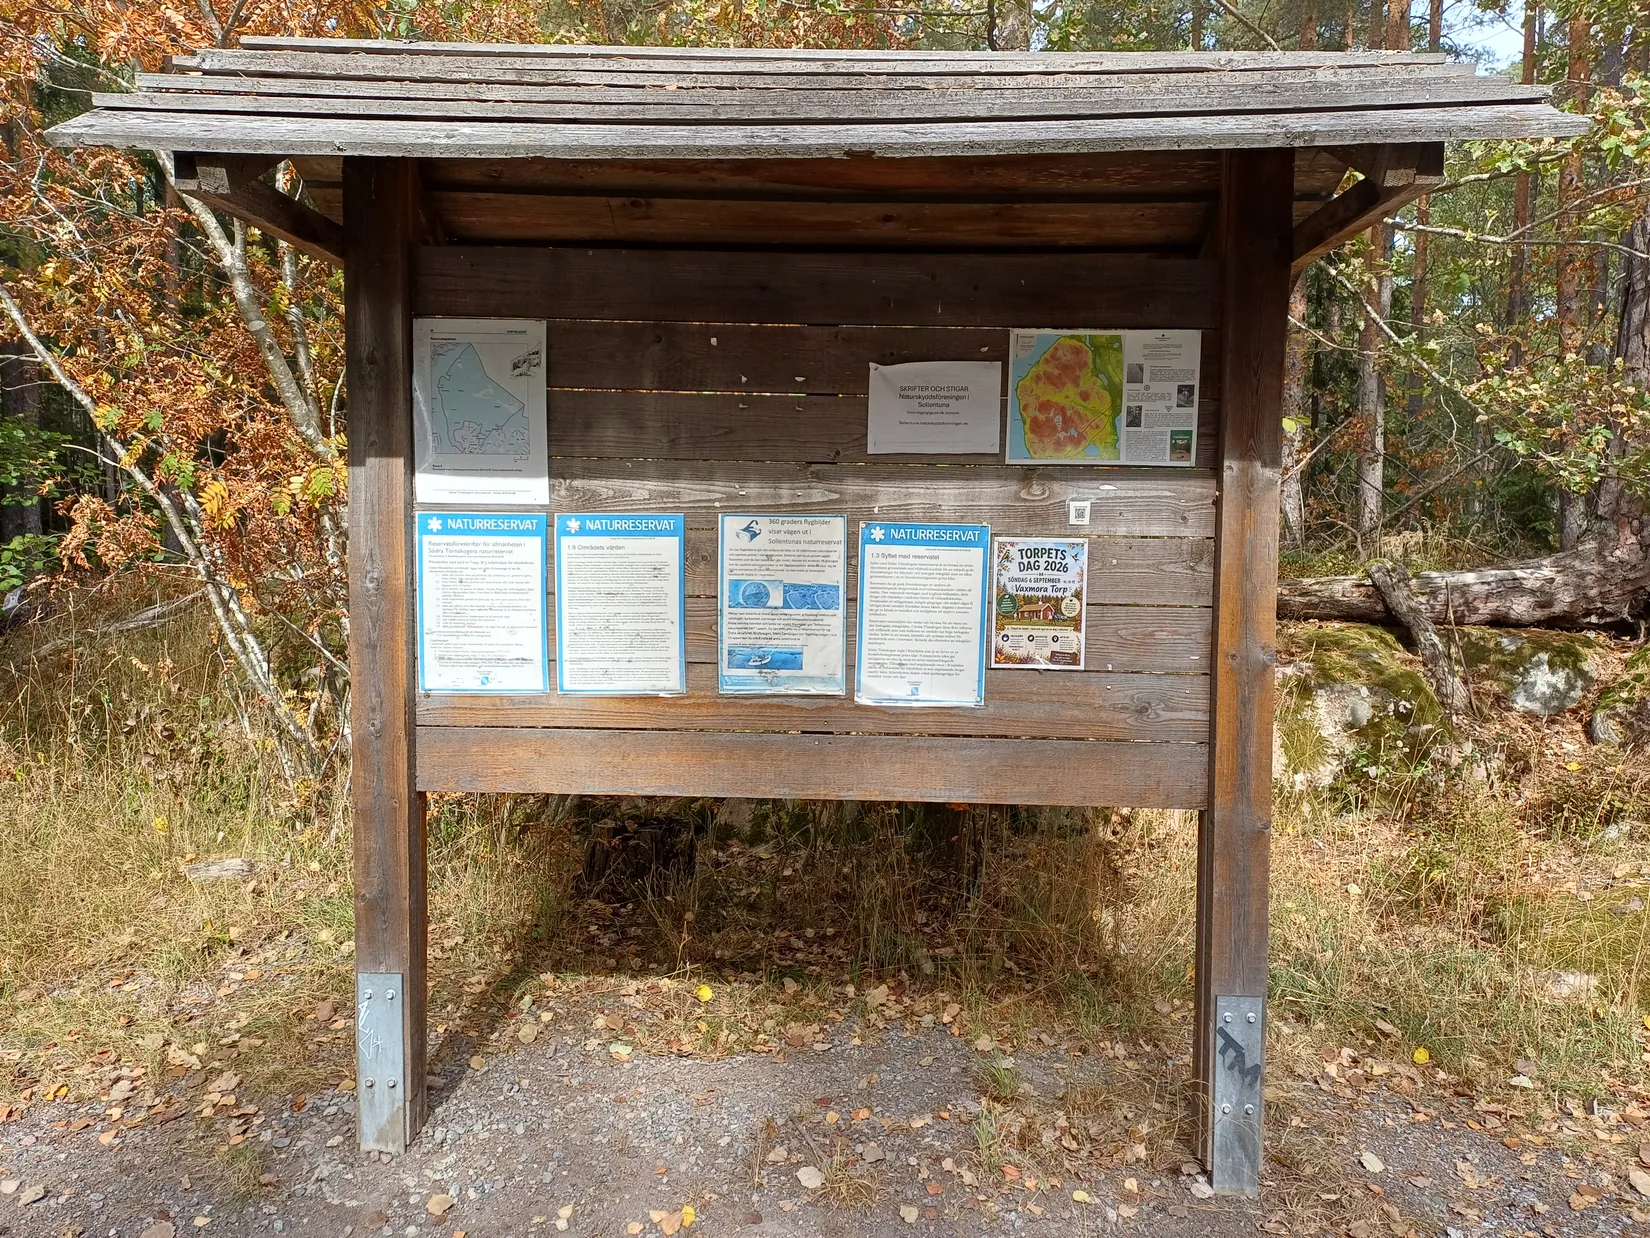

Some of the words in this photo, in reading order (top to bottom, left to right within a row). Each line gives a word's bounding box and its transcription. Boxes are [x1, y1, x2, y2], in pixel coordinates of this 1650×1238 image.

[447, 518, 538, 530] NATURRESERVAT
[586, 519, 675, 531] NATURRESERVAT
[803, 518, 831, 527] flygbilder
[890, 528, 980, 542] NATURRESERVAT
[1018, 548, 1067, 560] TORPETS
[1018, 560, 1040, 572] DAG
[1044, 560, 1069, 573] 2026
[1014, 584, 1048, 593] Vaxmora
[1050, 585, 1068, 595] Torp
